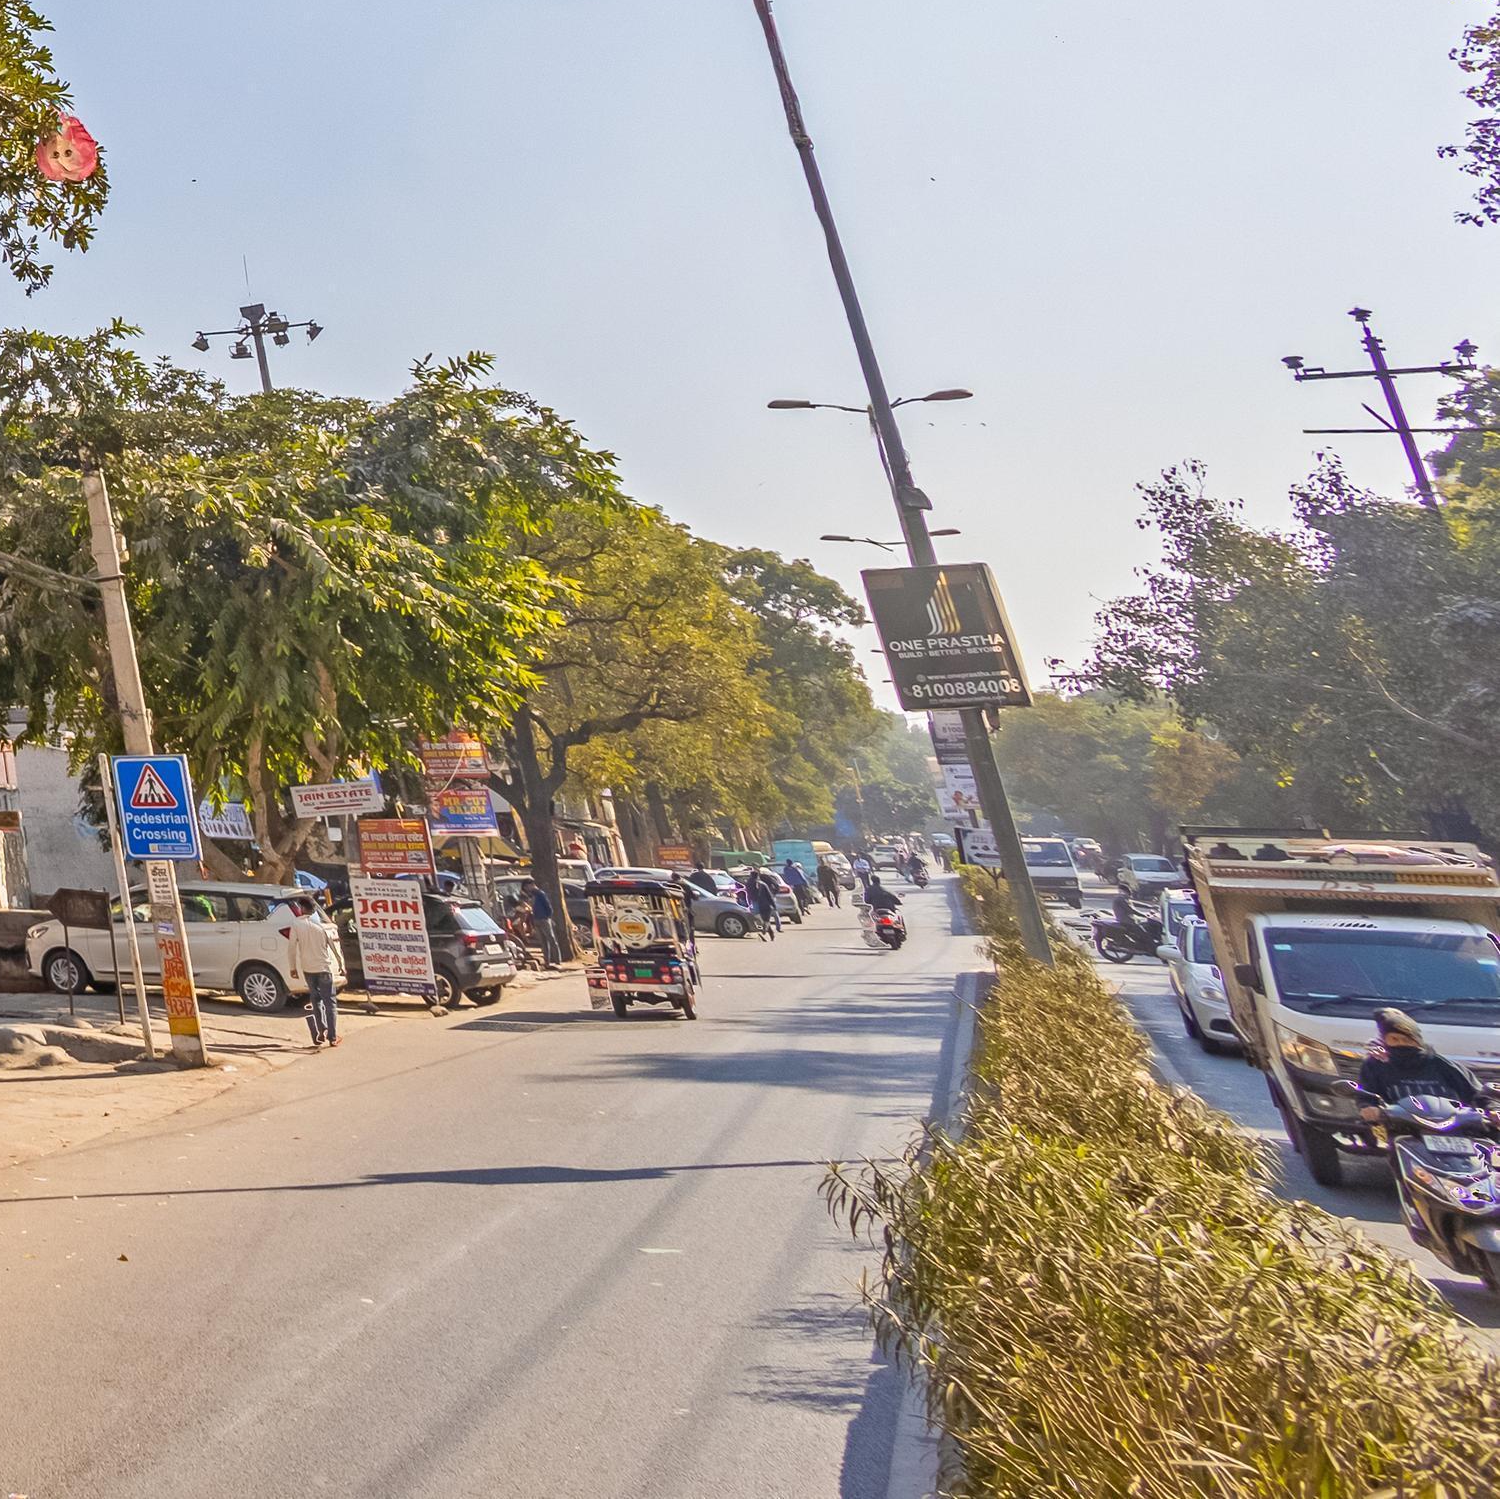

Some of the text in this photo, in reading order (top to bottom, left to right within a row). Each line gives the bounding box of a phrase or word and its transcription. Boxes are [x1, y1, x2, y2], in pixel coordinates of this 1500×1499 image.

[889, 634, 1005, 652] ONE PRASTHA
[898, 645, 1002, 659] BUILD BETTER BEYOND
[911, 678, 1021, 698] 8100884008
[298, 791, 325, 803] JAIN
[327, 788, 372, 799] ESTATE
[126, 812, 189, 825] Pedestrian
[133, 828, 187, 842] Crossing
[358, 898, 419, 915] JAIN
[360, 917, 422, 931] ESTATE
[361, 931, 424, 943] PROPERTY CONSULTANTS
[362, 942, 375, 950] SALE
[378, 942, 403, 952] PURCHASE
